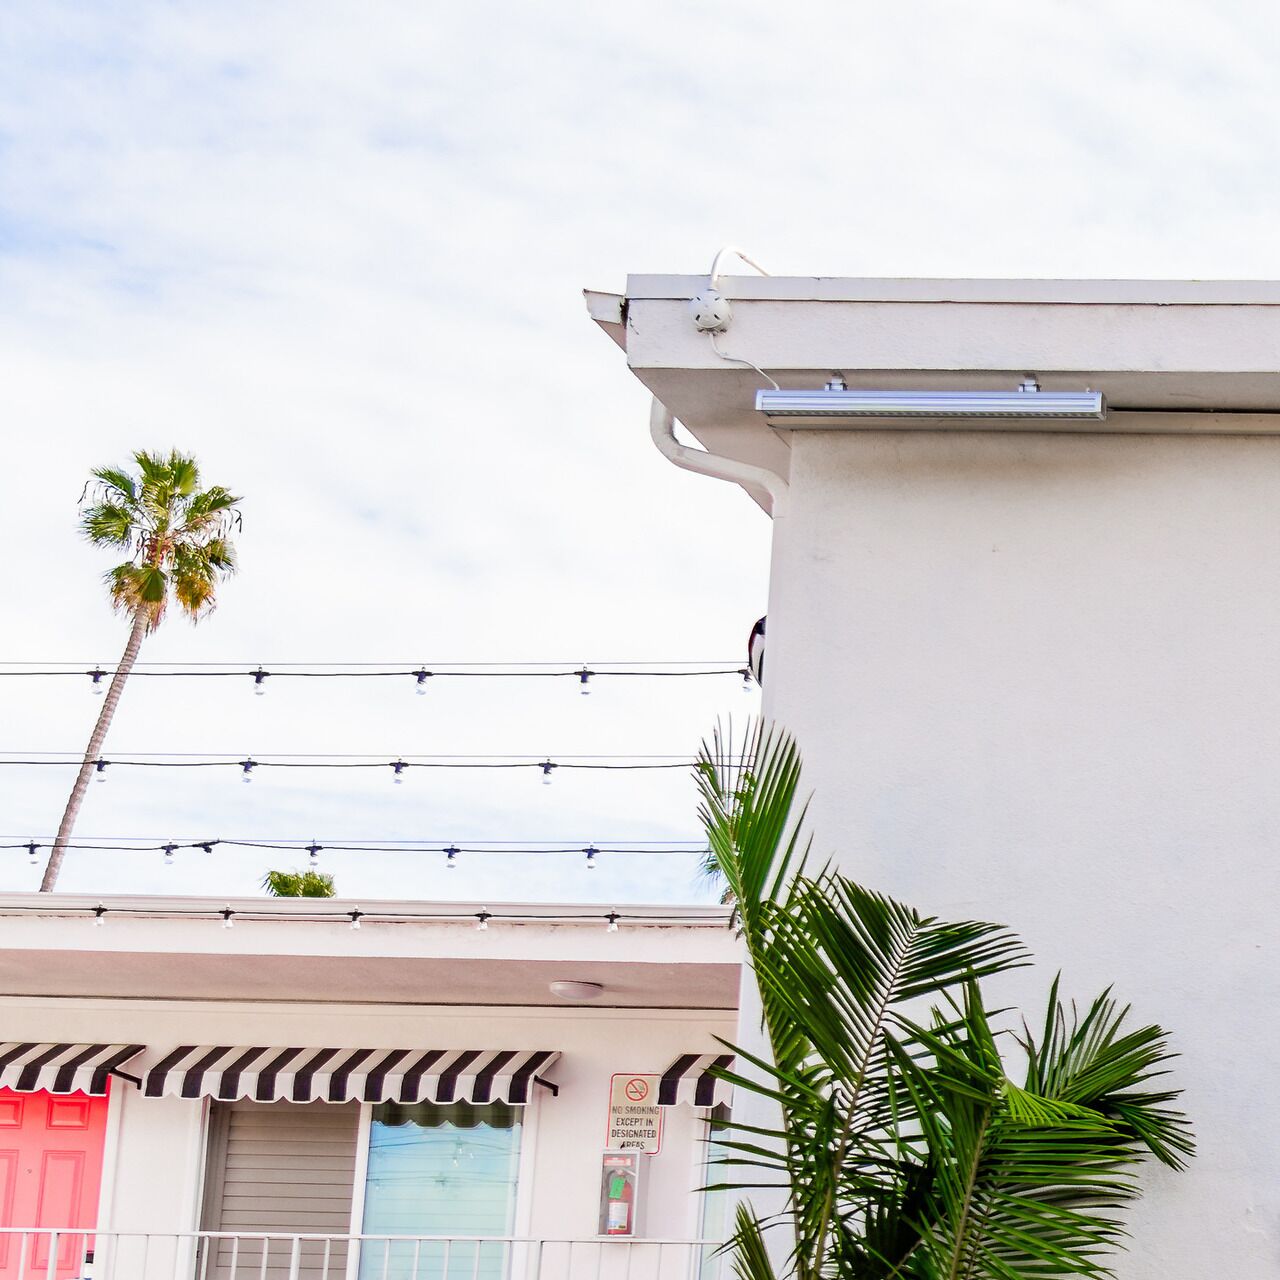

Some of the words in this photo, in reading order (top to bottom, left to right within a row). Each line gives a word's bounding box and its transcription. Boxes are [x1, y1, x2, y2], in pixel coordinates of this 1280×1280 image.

[612, 1106, 623, 1114] NO
[625, 1106, 660, 1115] SMOKING
[616, 1118, 643, 1126] EXCEPT
[646, 1118, 653, 1126] IN
[611, 1129, 657, 1138] DESIGNATED
